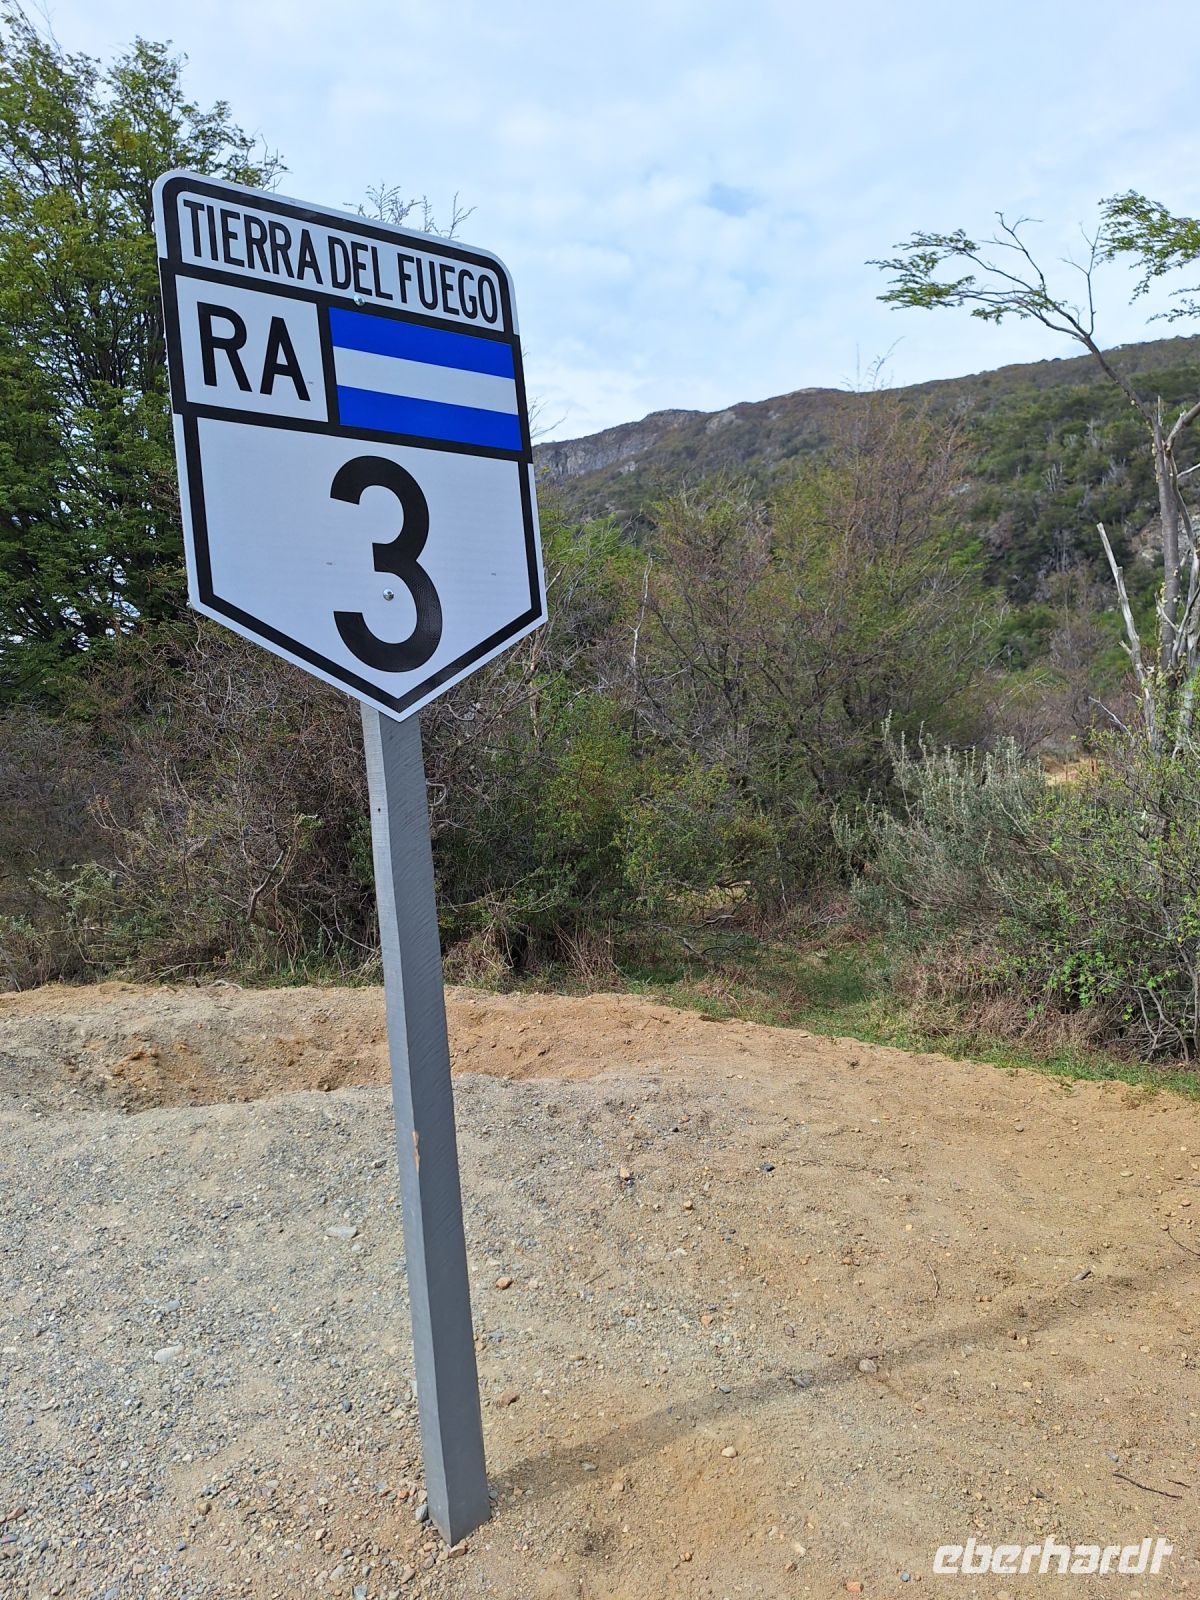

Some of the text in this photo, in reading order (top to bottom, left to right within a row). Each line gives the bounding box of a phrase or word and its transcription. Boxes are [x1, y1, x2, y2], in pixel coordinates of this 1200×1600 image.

[183, 200, 498, 324] TIERRA DEL FUEGO
[197, 301, 311, 402] RA
[330, 455, 443, 673] 3
